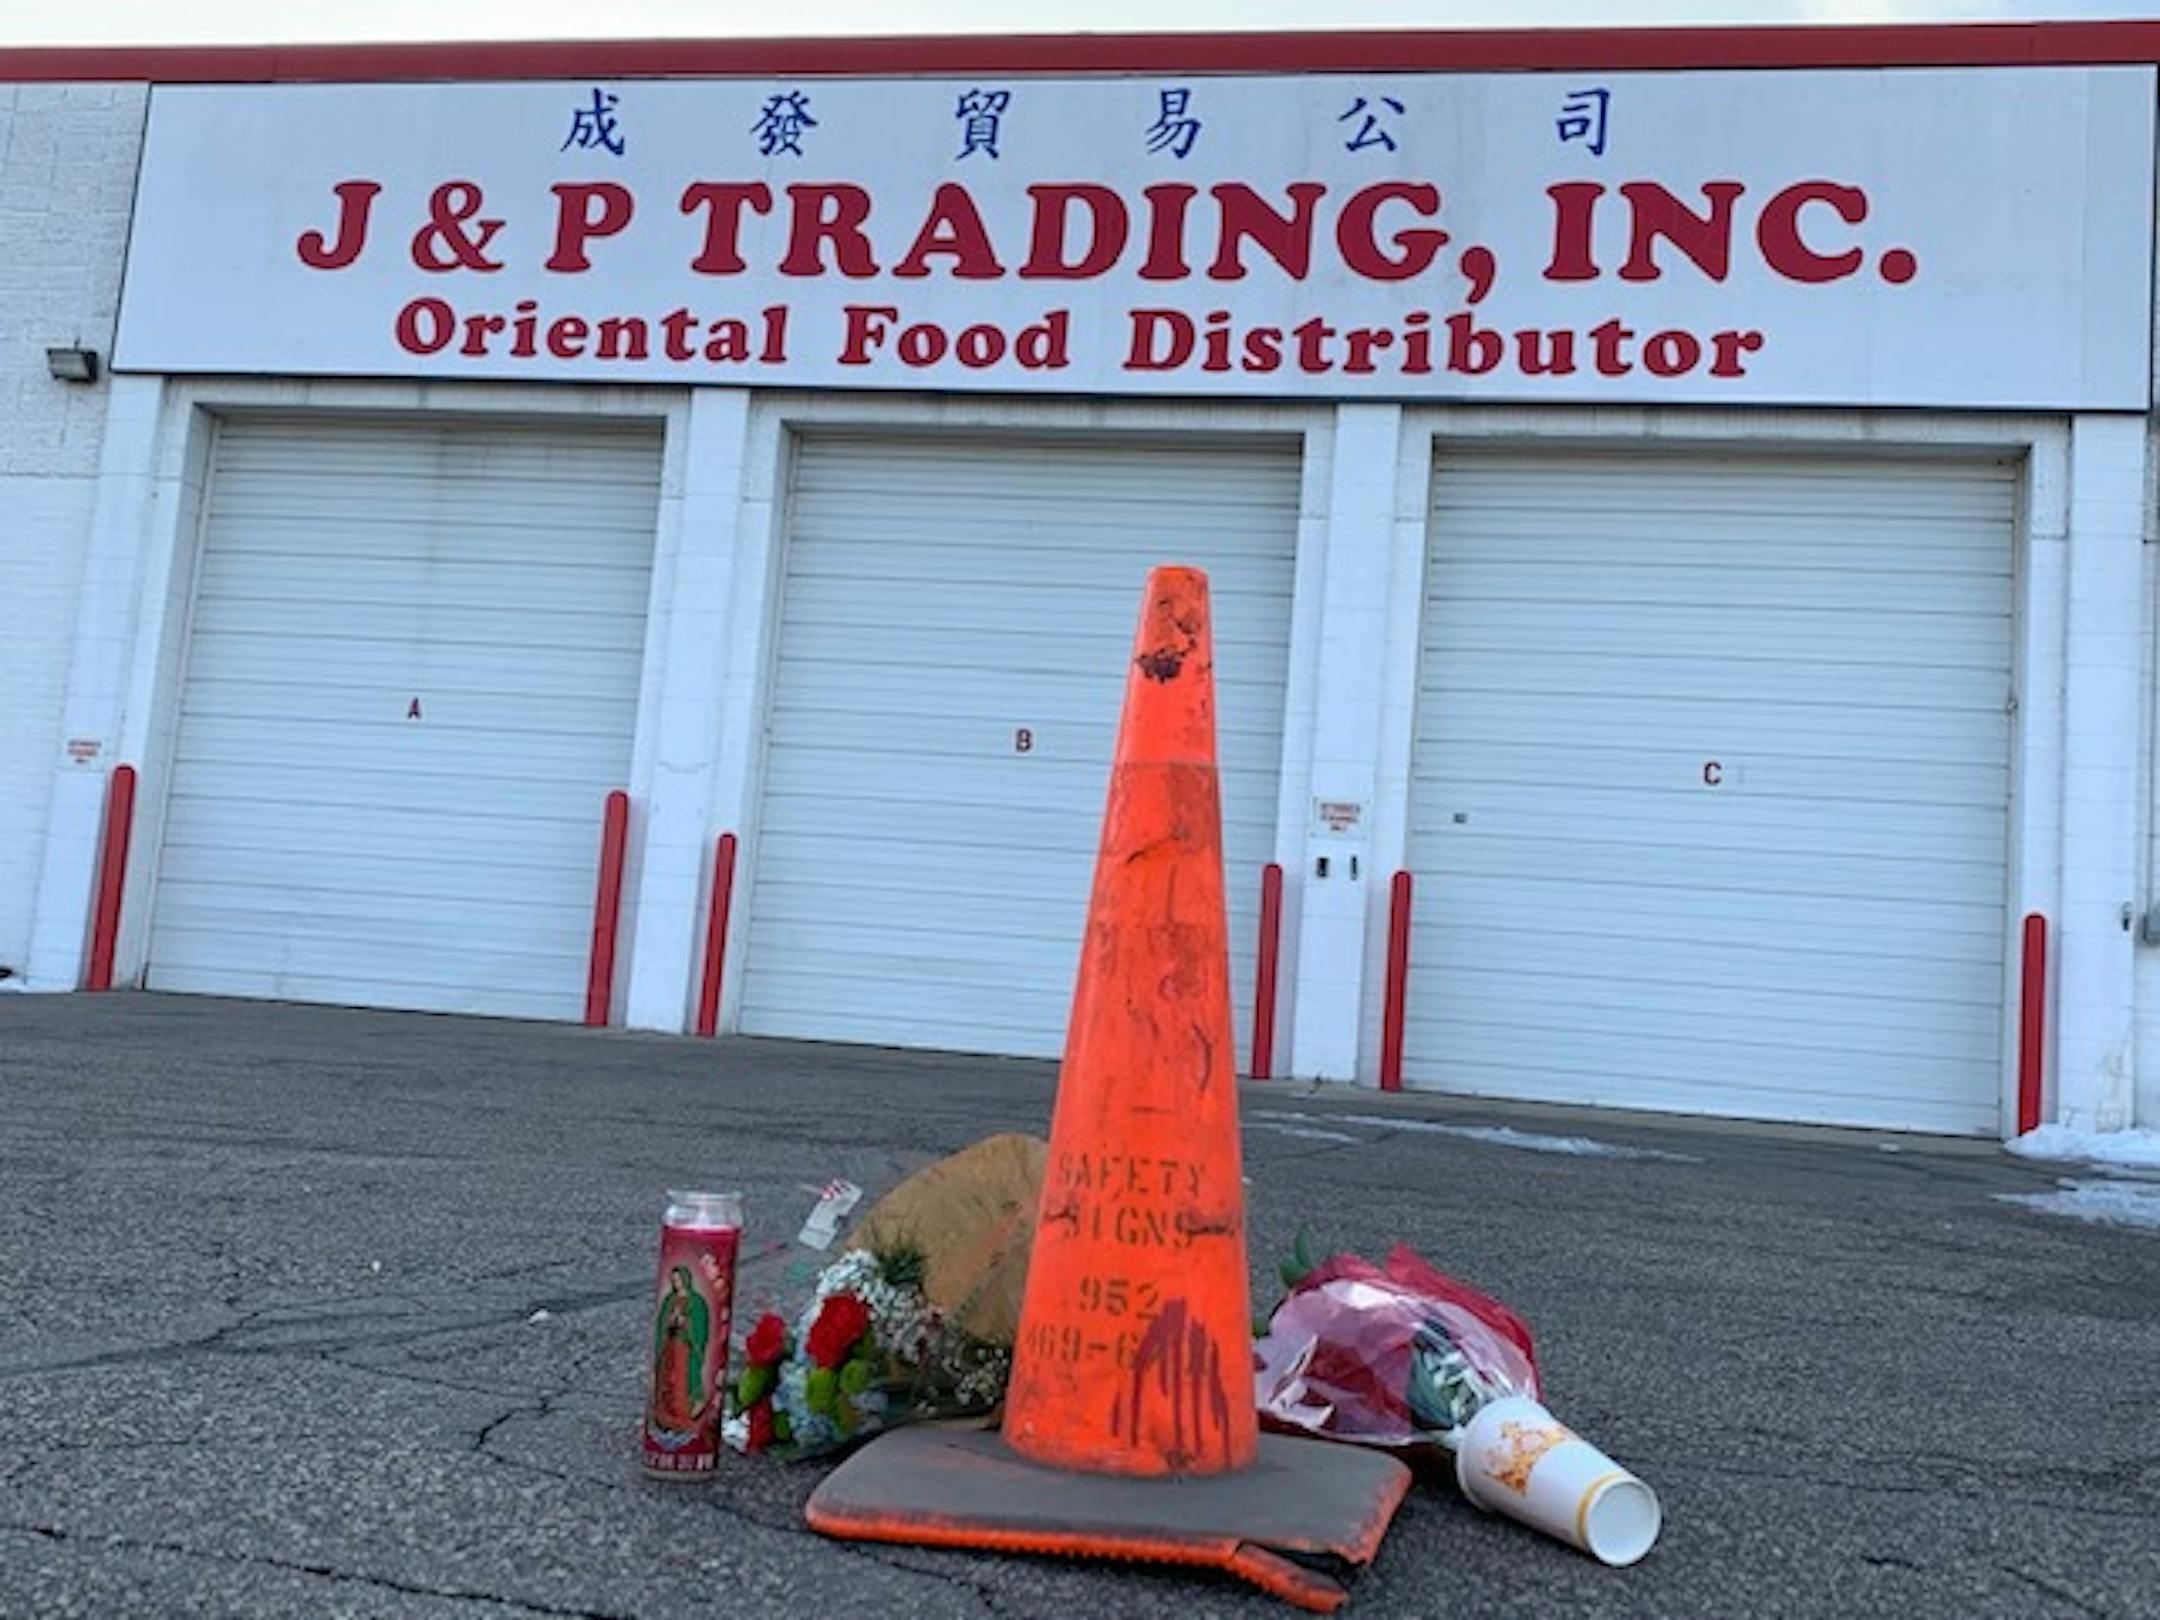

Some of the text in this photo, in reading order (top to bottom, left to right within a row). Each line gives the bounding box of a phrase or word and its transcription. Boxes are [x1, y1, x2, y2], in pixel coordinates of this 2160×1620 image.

[560, 88, 1611, 159] 成發貿易公司
[297, 181, 1916, 304] J & P TRADING, INC.
[397, 298, 1762, 378] Oriental Food Distributor
[408, 697, 421, 719] A
[1016, 728, 1032, 752] B
[1704, 761, 1722, 786] C
[1059, 1152, 1206, 1198] SAFETY
[1060, 1202, 1194, 1249] SIGNS
[1079, 1277, 1160, 1320] 952
